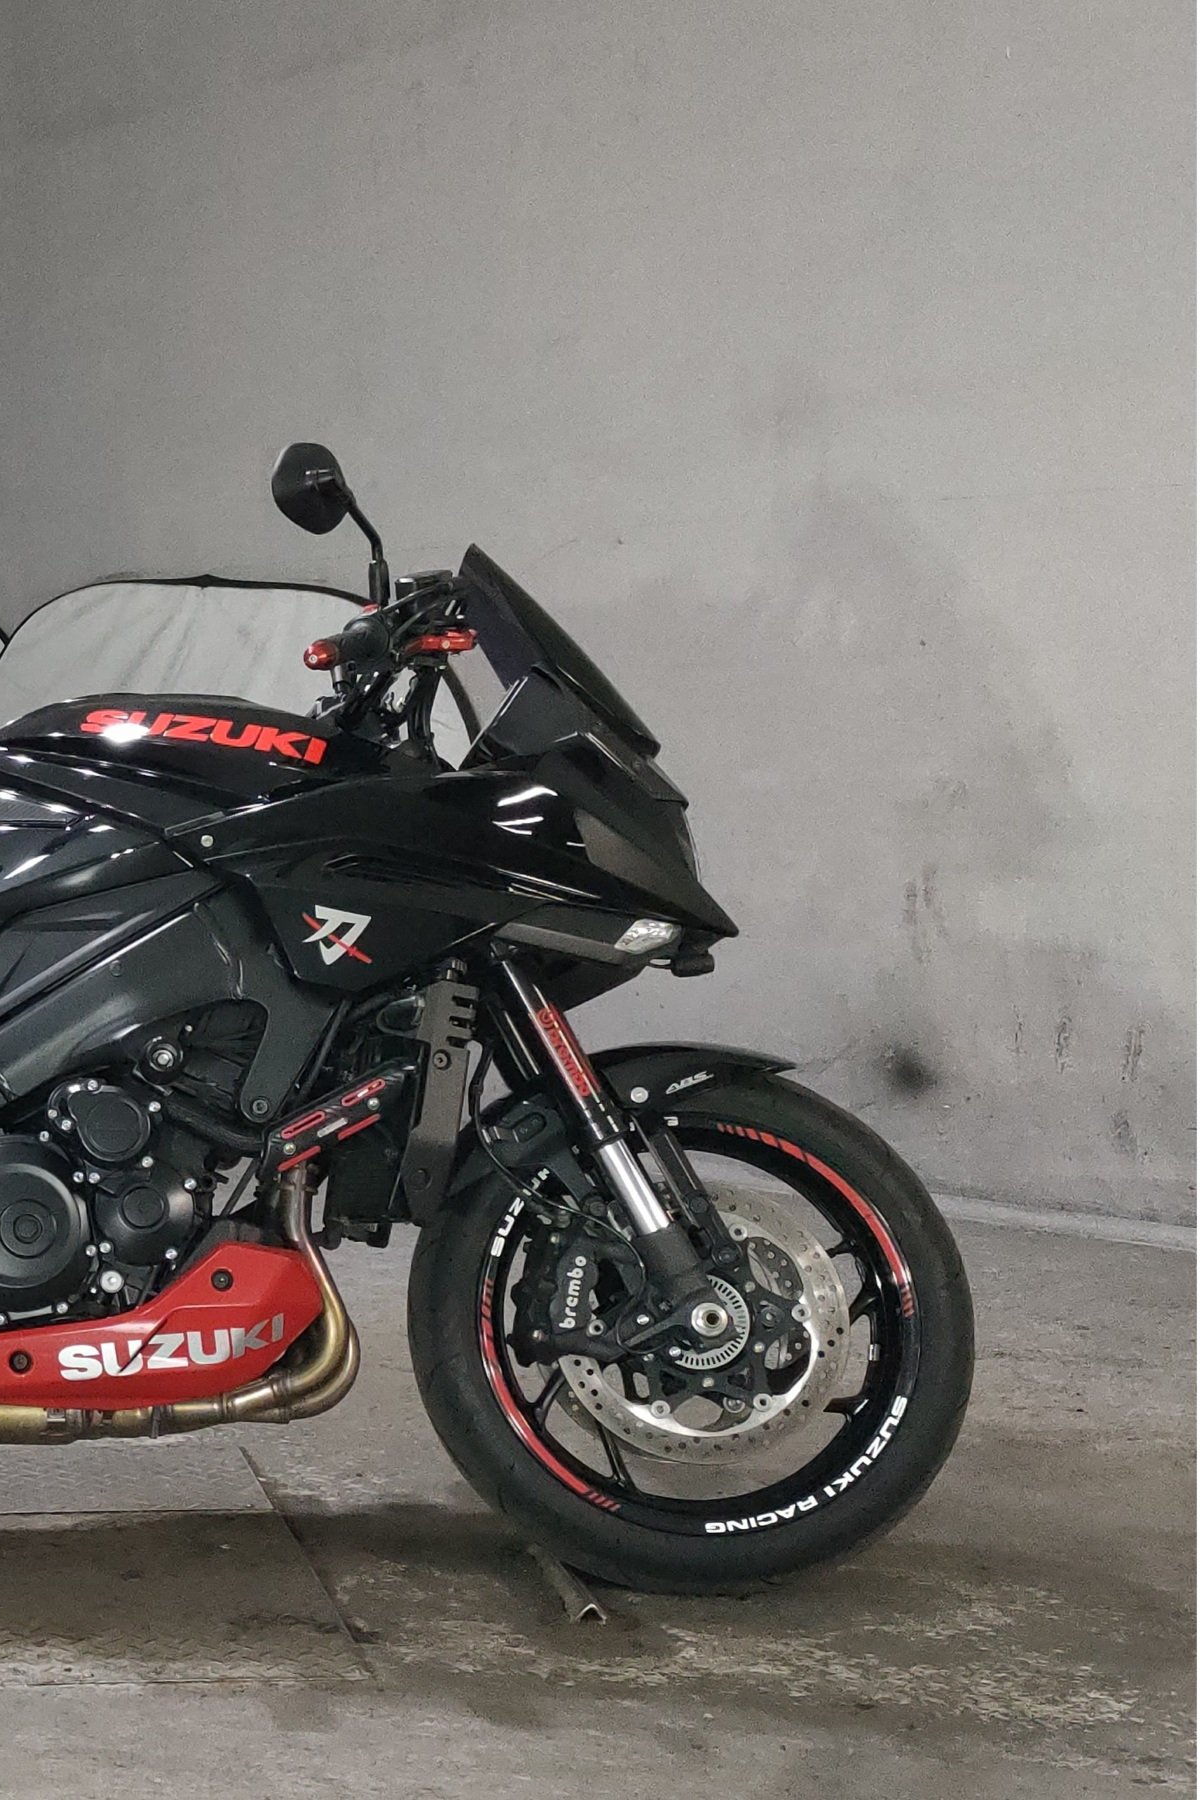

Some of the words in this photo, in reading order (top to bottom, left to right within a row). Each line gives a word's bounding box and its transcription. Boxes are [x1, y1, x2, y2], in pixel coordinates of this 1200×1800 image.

[80, 709, 327, 765] SUZUKI
[665, 1070, 714, 1095] ABS
[491, 1167, 550, 1257] SUZUK
[558, 1255, 587, 1329] brembo
[58, 1313, 285, 1382] SUZUKI
[823, 1395, 908, 1498] SUZUKI
[704, 1495, 819, 1534] RACING
